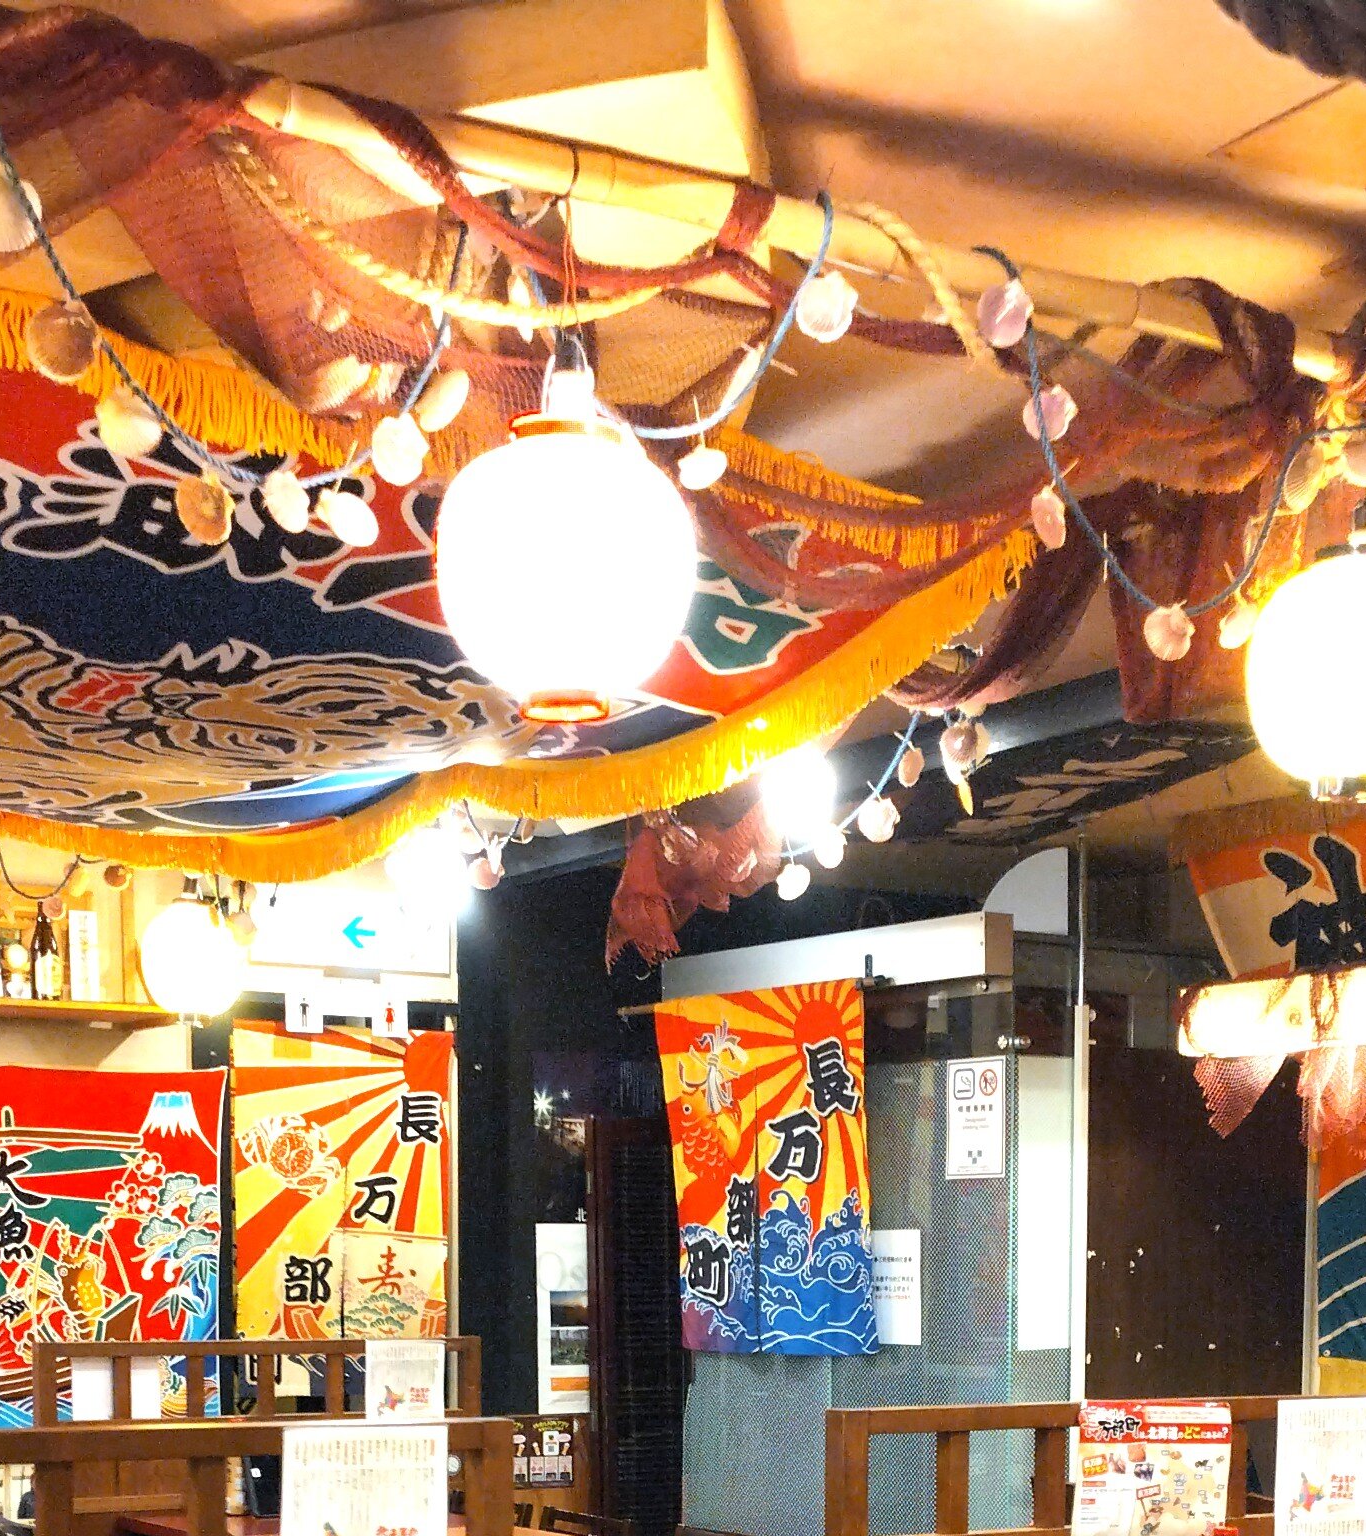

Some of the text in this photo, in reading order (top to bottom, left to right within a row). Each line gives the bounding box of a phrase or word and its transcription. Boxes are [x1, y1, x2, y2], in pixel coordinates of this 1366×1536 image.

[686, 1037, 860, 1306] 長万部町
[358, 1246, 416, 1295] 寿
